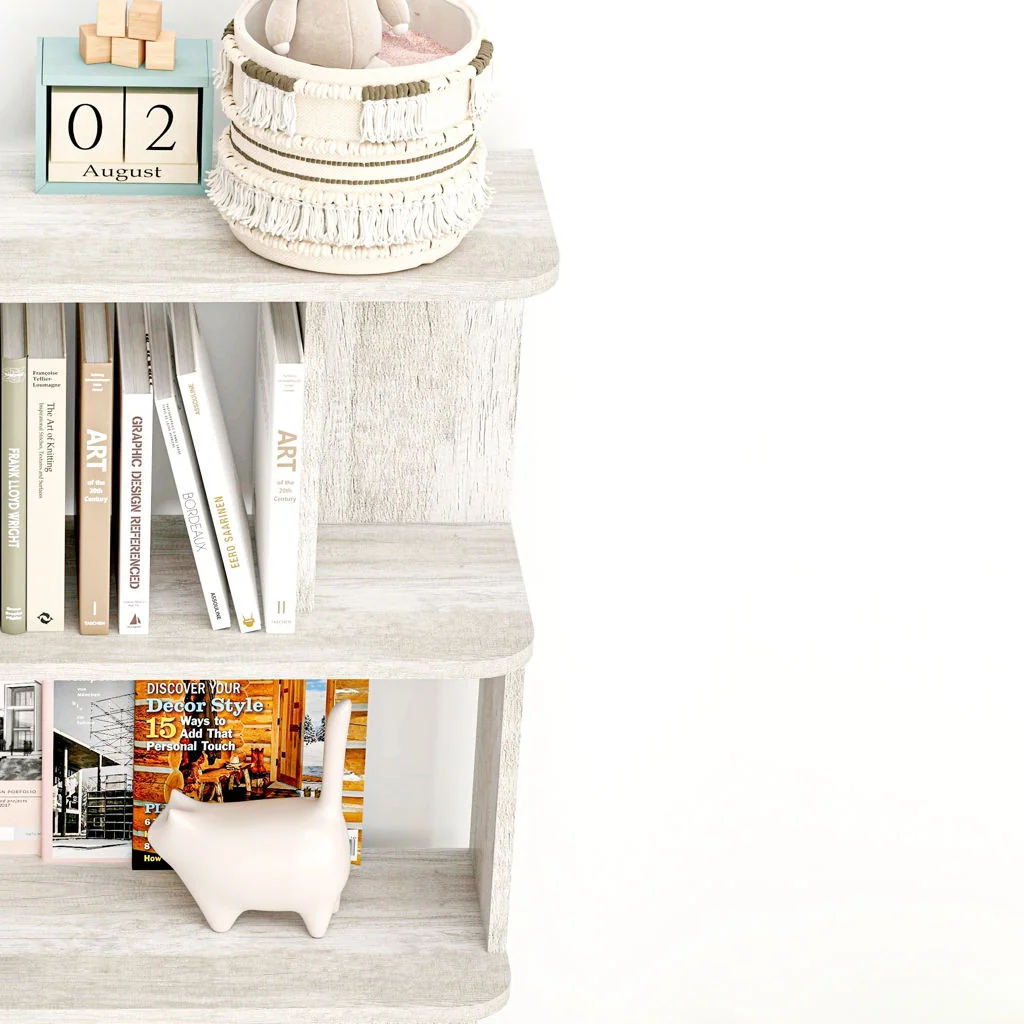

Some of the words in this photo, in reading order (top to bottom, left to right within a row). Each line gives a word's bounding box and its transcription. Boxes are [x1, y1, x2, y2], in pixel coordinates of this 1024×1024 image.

[67, 103, 103, 151] 0
[145, 103, 177, 152] 2
[82, 163, 163, 182] August
[46, 403, 56, 417] The
[46, 418, 56, 431] Art
[86, 428, 108, 473] ART
[131, 416, 143, 468] GRAPHIC
[276, 429, 298, 472] ART
[7, 447, 20, 478] FRANK
[44, 442, 55, 473] Knitting
[8, 480, 20, 510] LLOYD
[83, 496, 109, 504] Century
[130, 471, 142, 513] DESIGN
[7, 511, 20, 549] WRIGHT
[182, 492, 207, 552] BORDEAUX
[213, 495, 234, 543] SAARINEN
[129, 516, 141, 590] REFERENCED
[225, 545, 240, 569] EERO
[209, 592, 222, 621] ASSOULINE
[146, 682, 205, 695] DISCOVER
[208, 682, 241, 694] YOUR
[145, 697, 207, 713] Decor
[210, 697, 264, 716] Style
[145, 716, 177, 740] 15
[180, 715, 211, 728] Ways
[214, 716, 226, 726] to
[180, 728, 203, 739] Add
[206, 728, 233, 739] That
[146, 741, 197, 752] Personal
[201, 741, 236, 752] Touch
[143, 854, 161, 862] How
